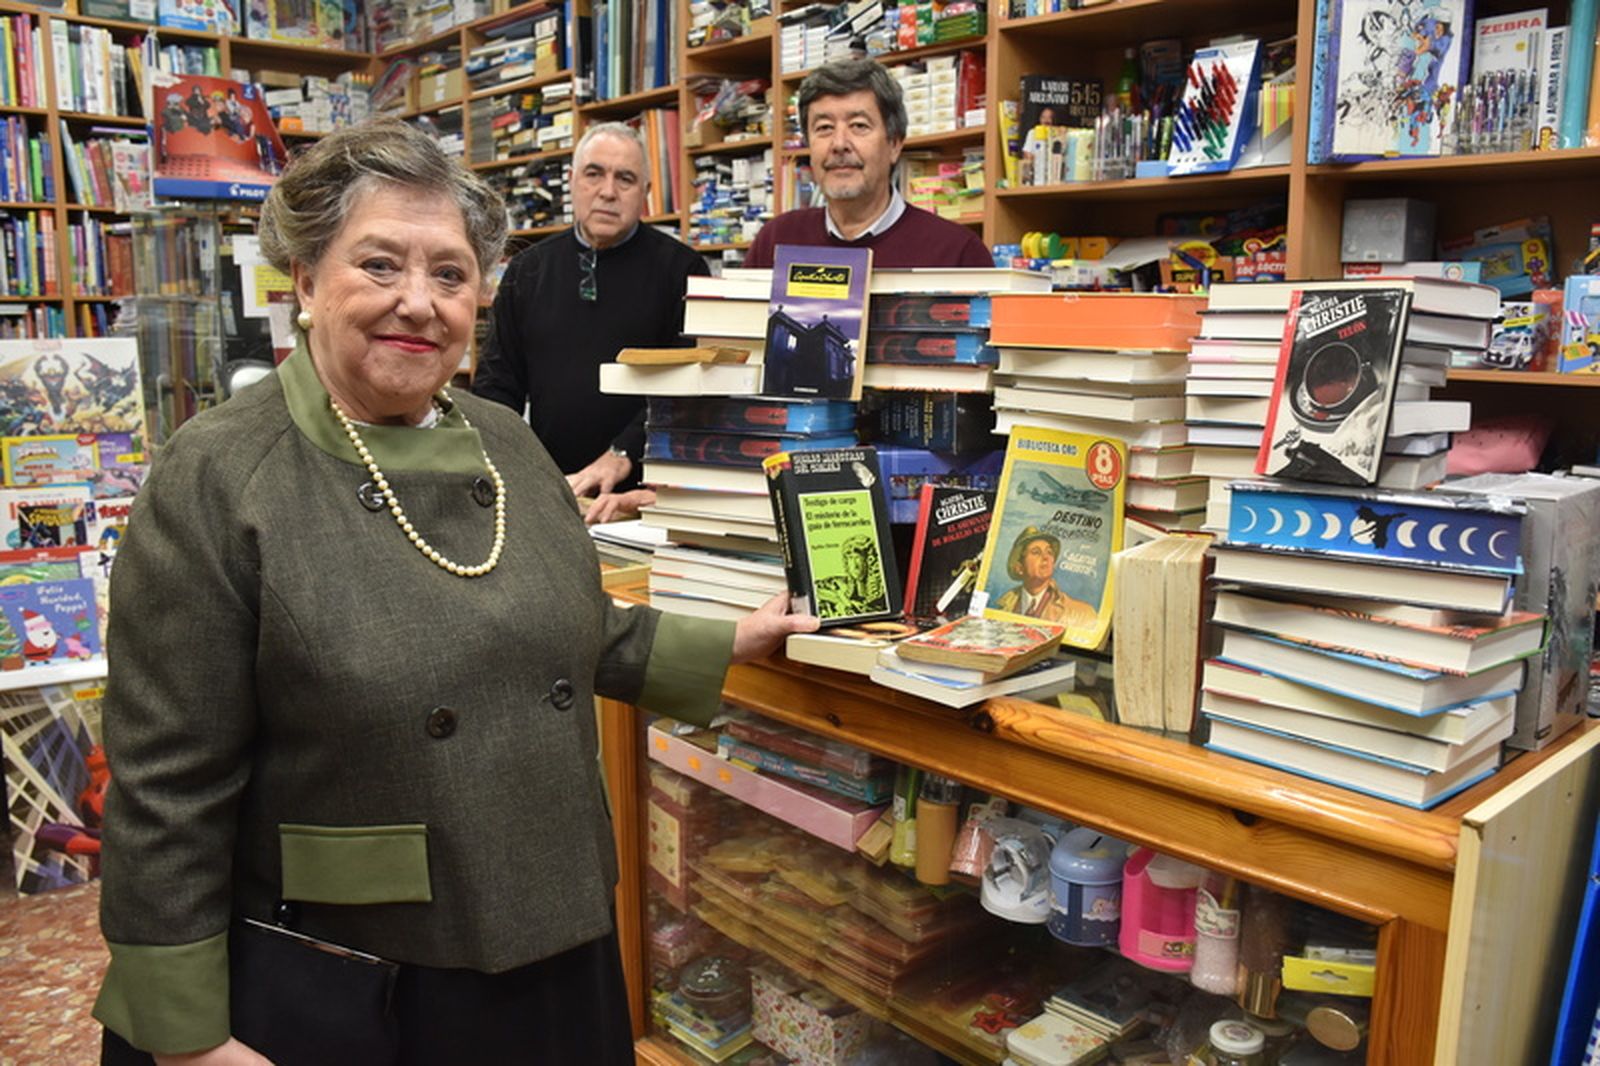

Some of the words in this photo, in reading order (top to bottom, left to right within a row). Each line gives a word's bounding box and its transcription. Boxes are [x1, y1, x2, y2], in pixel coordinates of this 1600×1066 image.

[1480, 17, 1541, 36] ZEBRA
[1071, 82, 1100, 105] 545
[1304, 294, 1367, 332] CHRISTIE
[1017, 439, 1060, 453] BIBLIOTECA
[1062, 445, 1078, 456] ORO
[1094, 444, 1114, 474] 8
[803, 498, 827, 506] Testigo
[838, 497, 856, 505] carga
[936, 494, 986, 519] CHRISTIE
[814, 511, 840, 519] misterio
[1053, 510, 1103, 528] DESTINO
